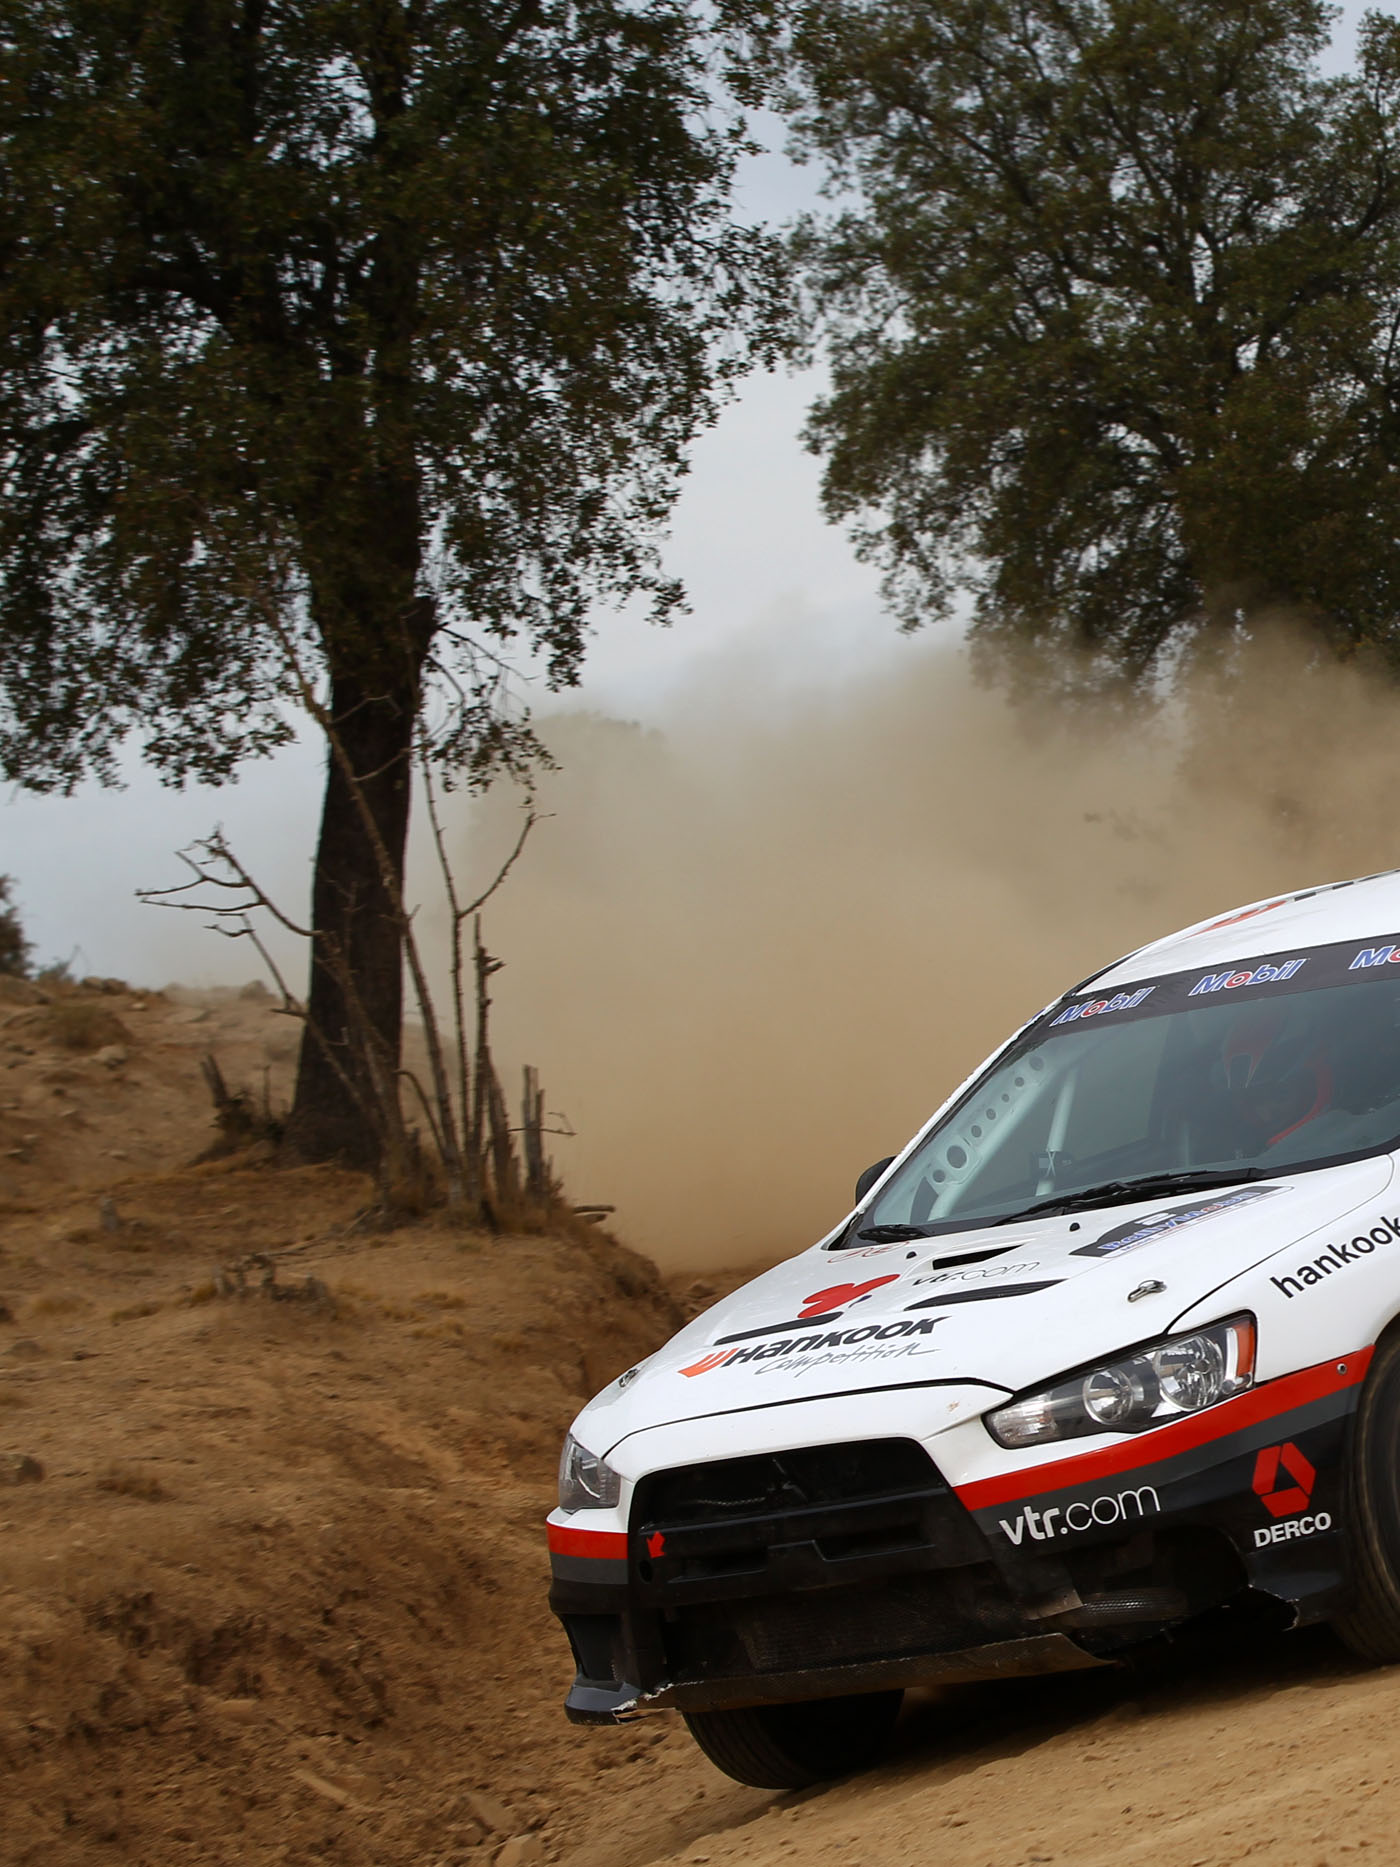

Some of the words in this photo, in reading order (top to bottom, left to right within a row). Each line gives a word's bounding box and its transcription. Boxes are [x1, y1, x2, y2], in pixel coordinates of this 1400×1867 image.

[1188, 958, 1307, 997] Mobil
[1050, 986, 1155, 1027] Mobil
[754, 1341, 943, 1378] Competition
[999, 1485, 1161, 1545] vtr.com
[1253, 1512, 1333, 1548] DERCO
